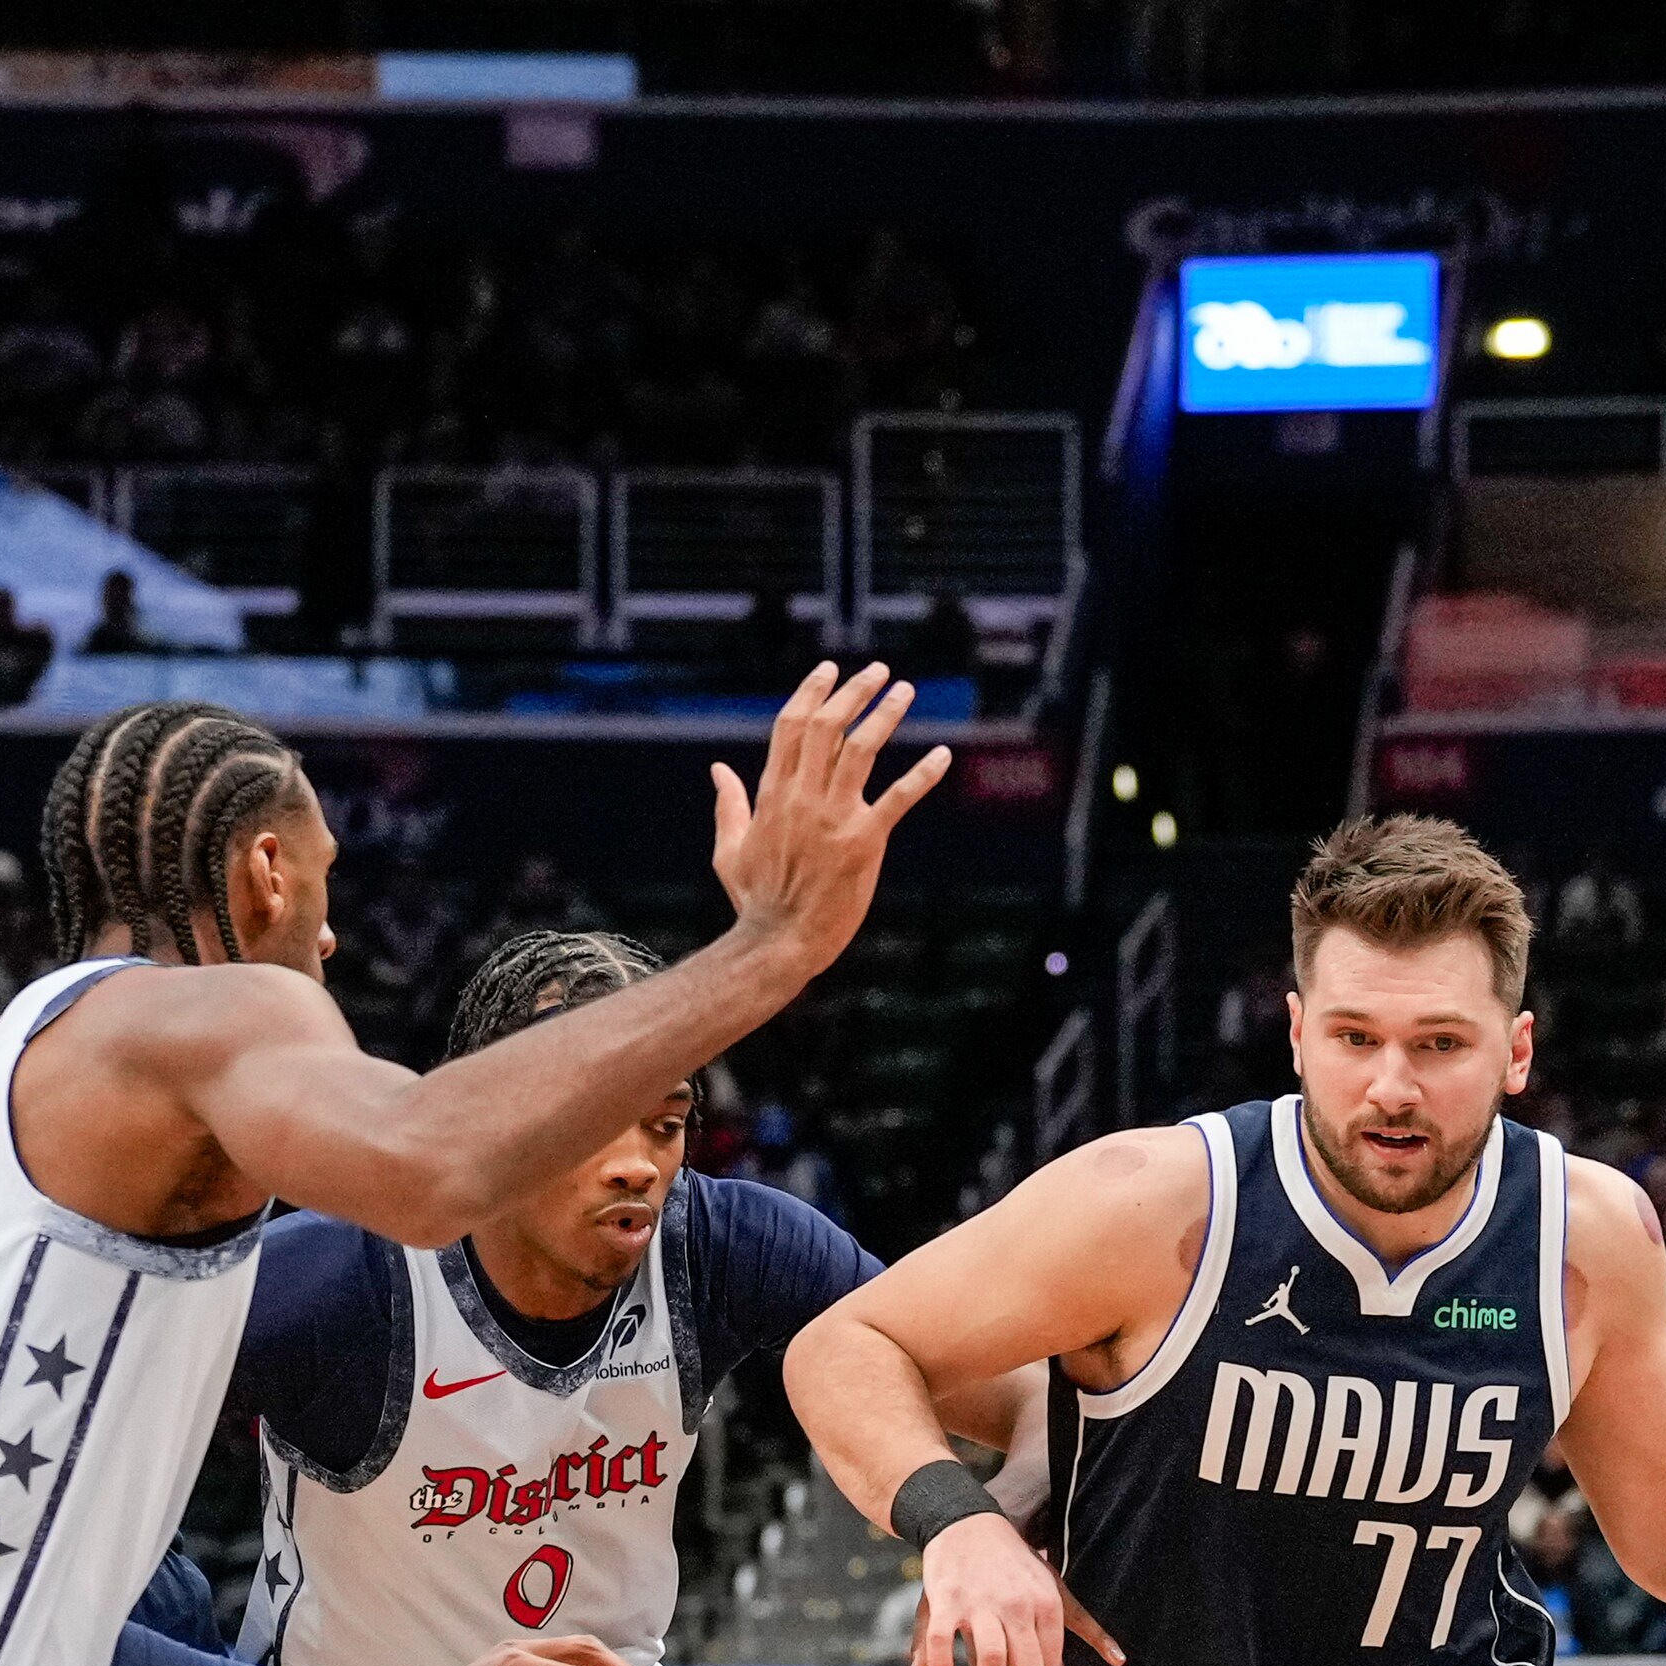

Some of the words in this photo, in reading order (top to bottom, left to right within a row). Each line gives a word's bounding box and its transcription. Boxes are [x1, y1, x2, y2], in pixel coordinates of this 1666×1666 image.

[1434, 1298, 1517, 1331] chime
[1198, 1361, 1520, 1508] MAVS
[410, 1484, 464, 1511] the
[422, 1529, 456, 1544] OF
[489, 1494, 650, 1536] COLUMBIA
[503, 1543, 573, 1631] 0
[1353, 1519, 1482, 1651] 77
